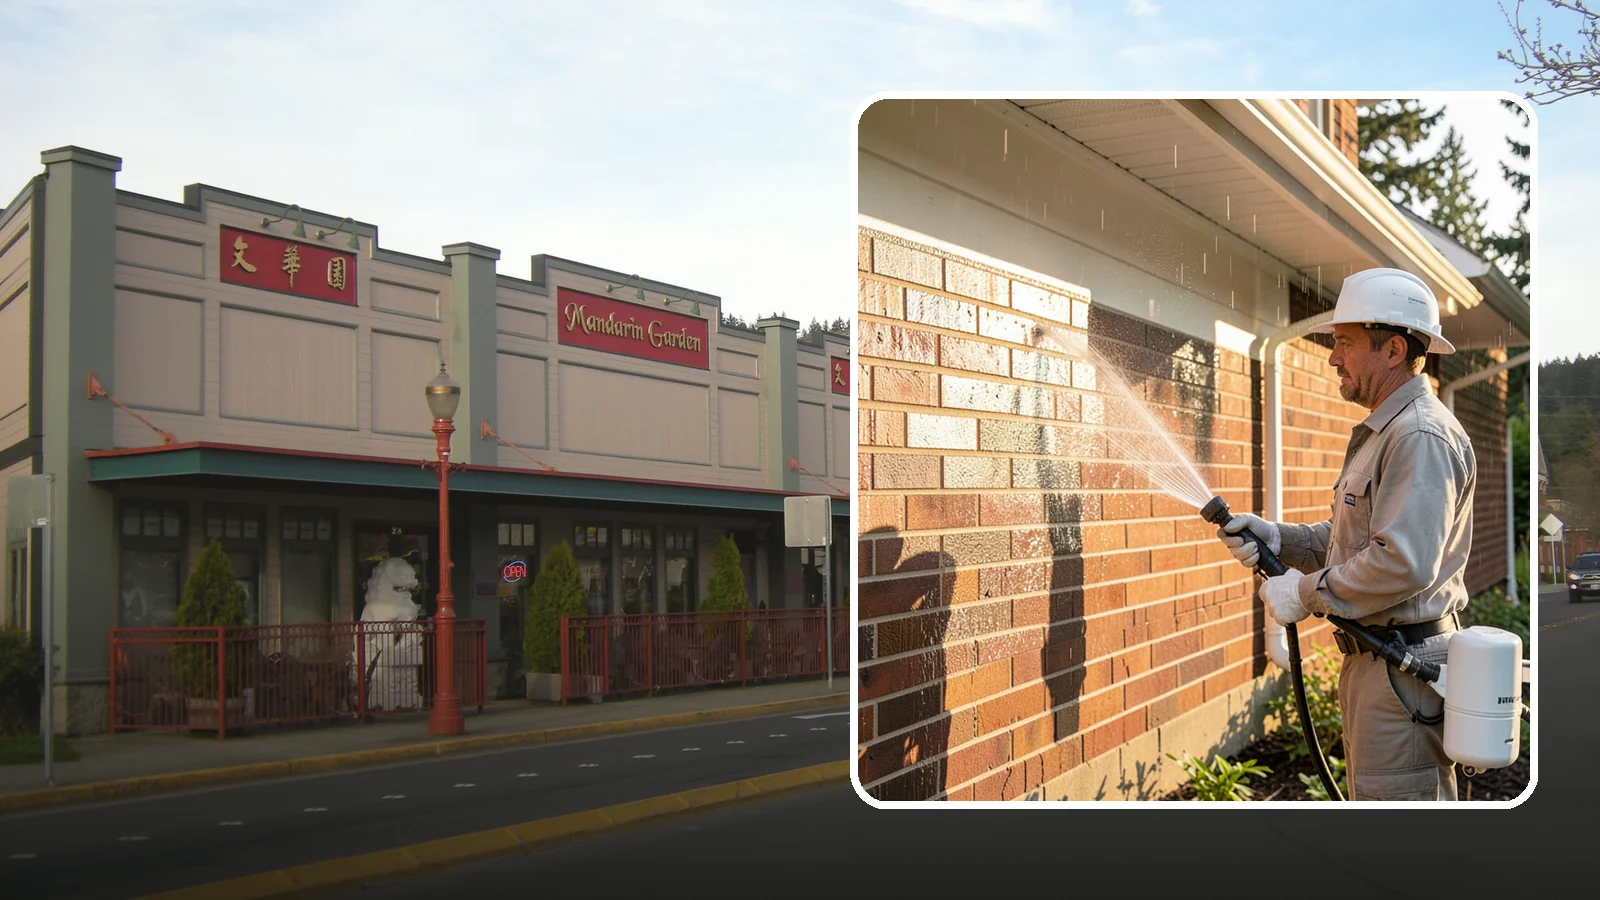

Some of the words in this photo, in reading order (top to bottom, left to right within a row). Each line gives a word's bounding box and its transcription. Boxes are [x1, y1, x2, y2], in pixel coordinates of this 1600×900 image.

[230, 235, 347, 291] 文華園
[564, 302, 644, 341] Mandarin
[647, 320, 702, 352] Garden
[503, 565, 527, 578] OPEN
